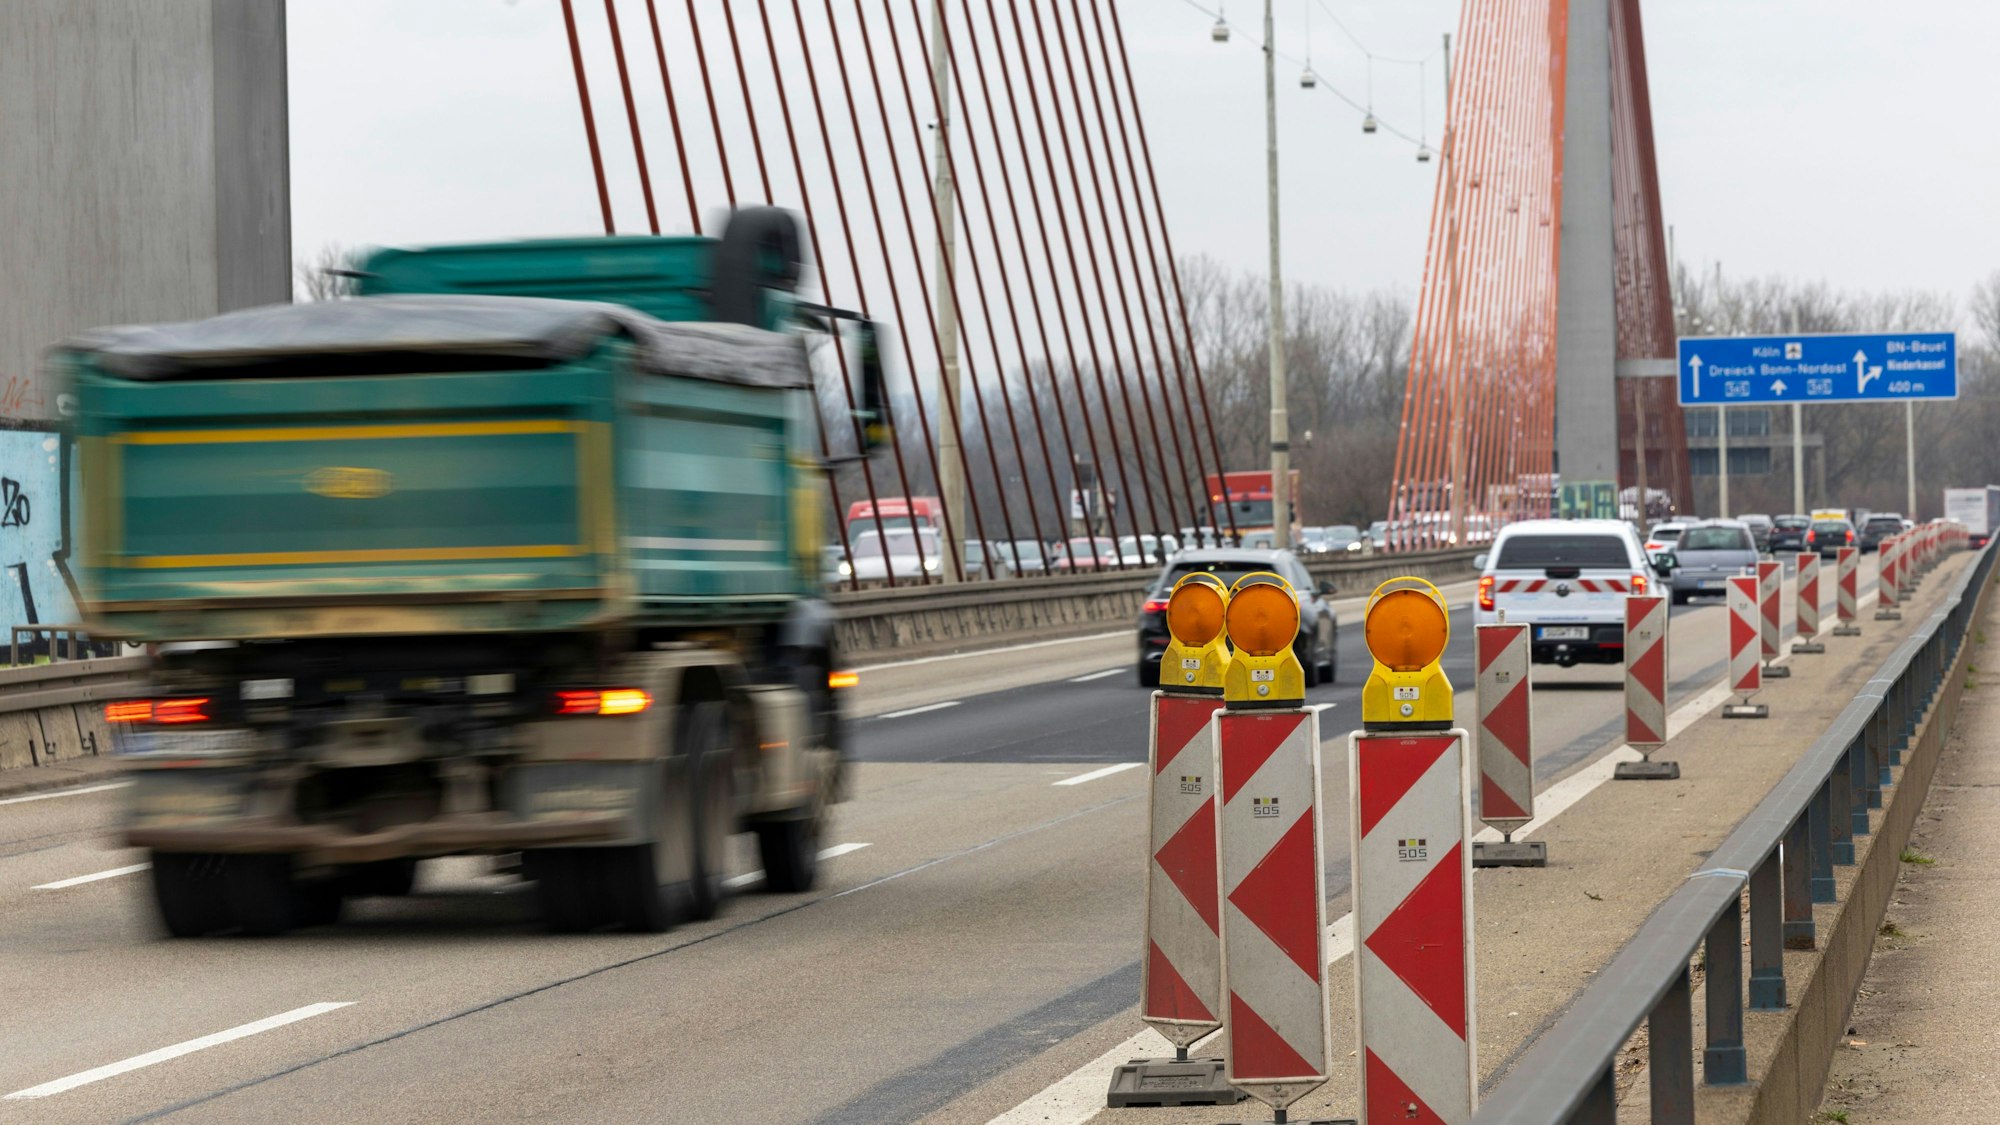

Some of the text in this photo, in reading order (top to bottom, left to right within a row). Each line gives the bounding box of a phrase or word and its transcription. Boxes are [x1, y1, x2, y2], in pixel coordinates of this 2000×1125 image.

[1752, 345, 1781, 357] Köln
[1709, 363, 1847, 377] Dreieck Bonn-Nordost
[1888, 380, 1925, 393] 400 m
[1180, 783, 1201, 792] SOS
[1253, 806, 1279, 815] SOS
[1398, 849, 1427, 858] SOS
